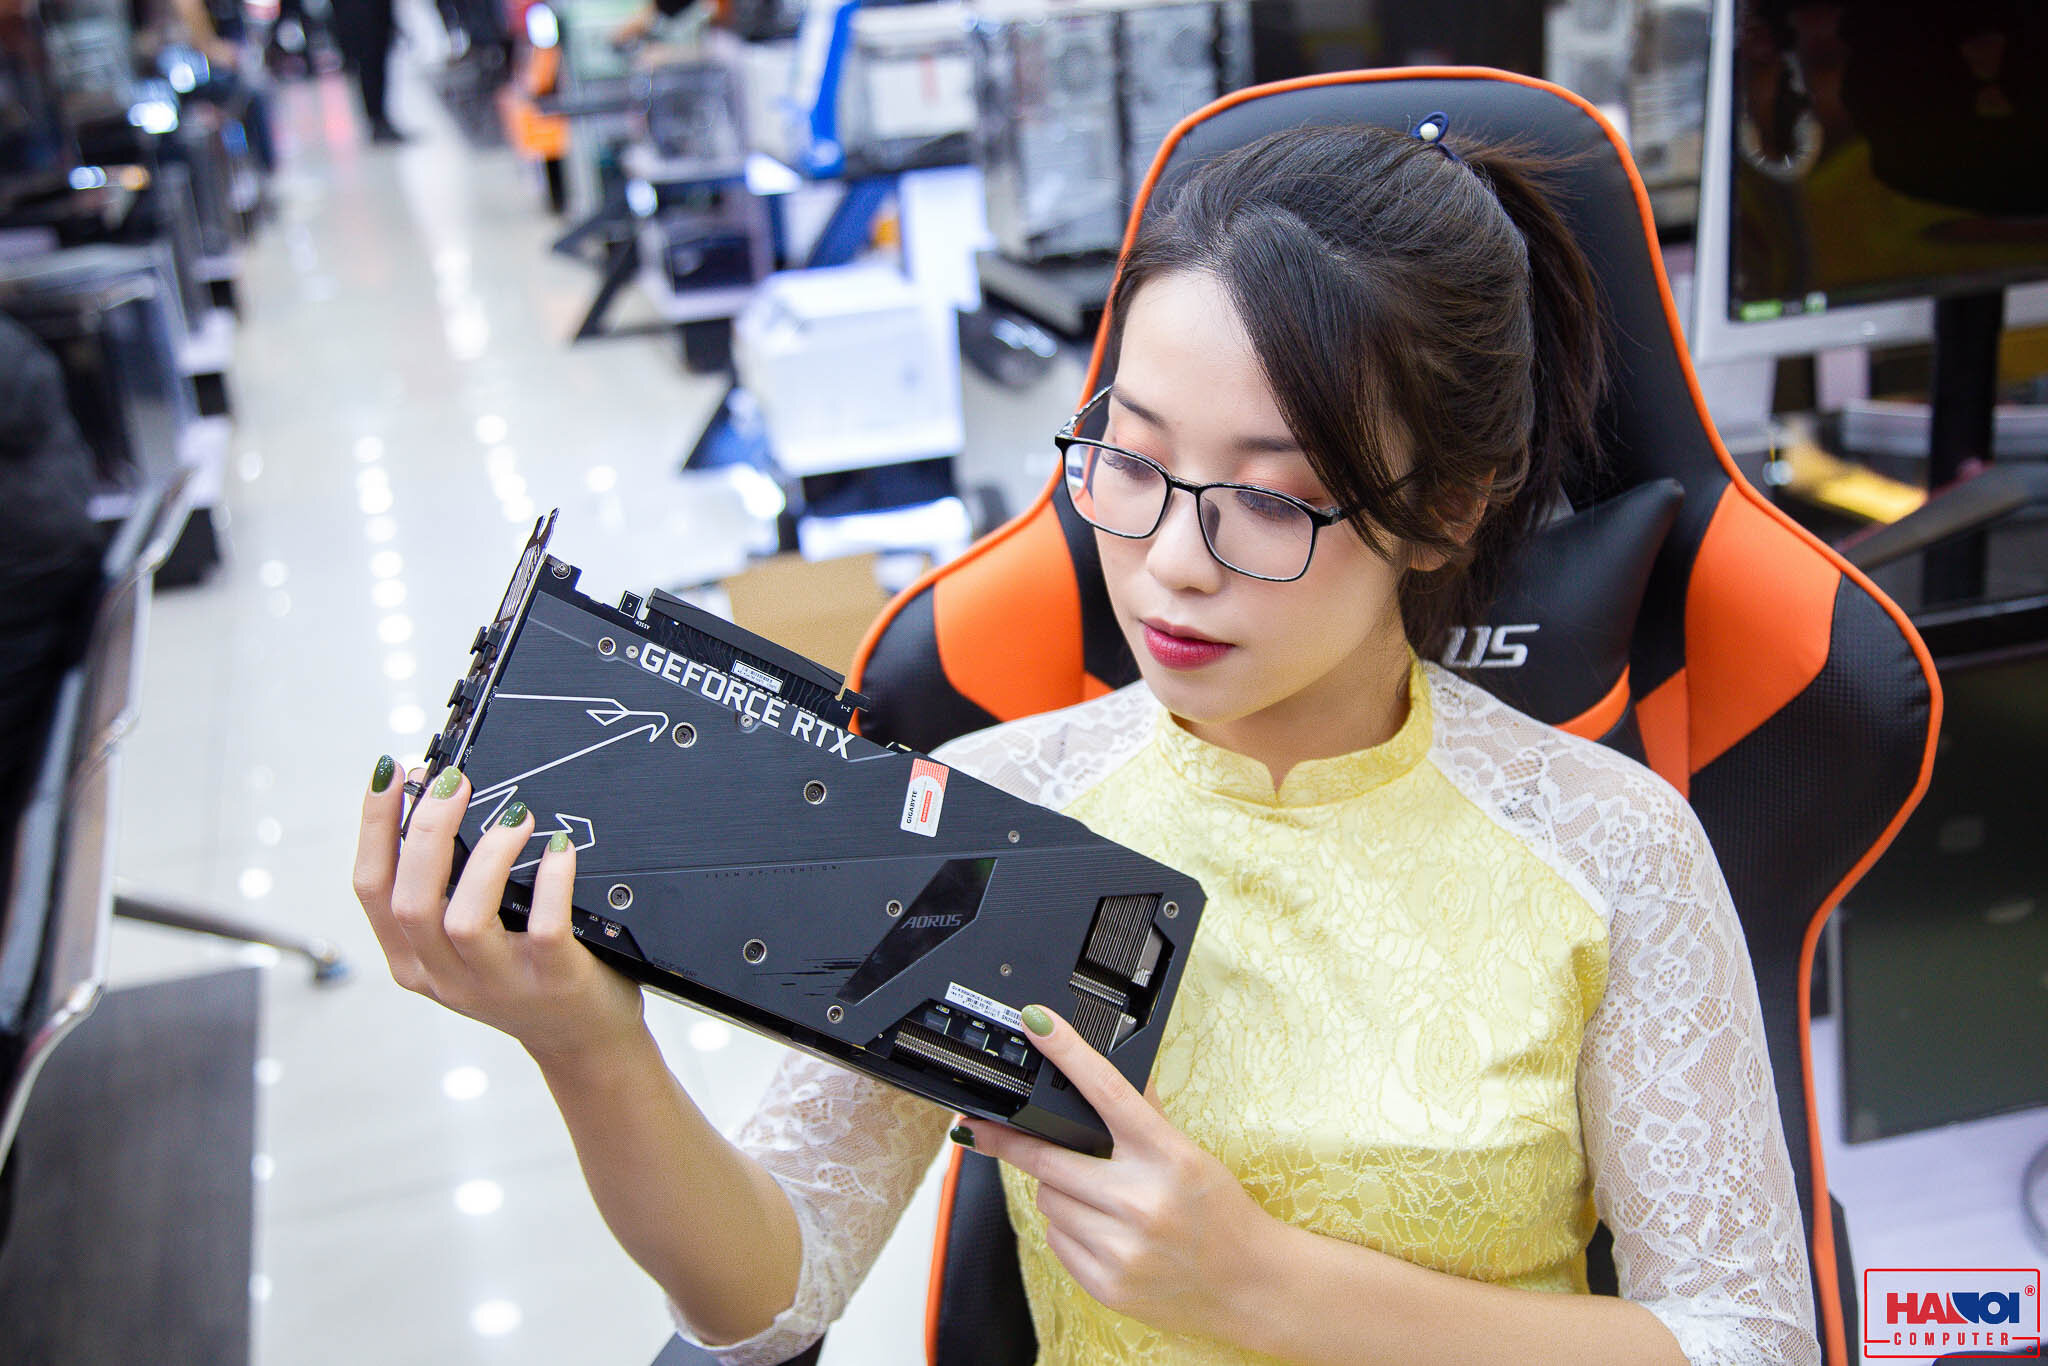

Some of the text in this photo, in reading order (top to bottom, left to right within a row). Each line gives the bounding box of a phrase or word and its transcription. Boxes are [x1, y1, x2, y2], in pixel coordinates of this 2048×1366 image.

[640, 642, 856, 760] GEFORCE RTX
[906, 791, 918, 824] GIGABYTE
[901, 913, 964, 929] AORUS
